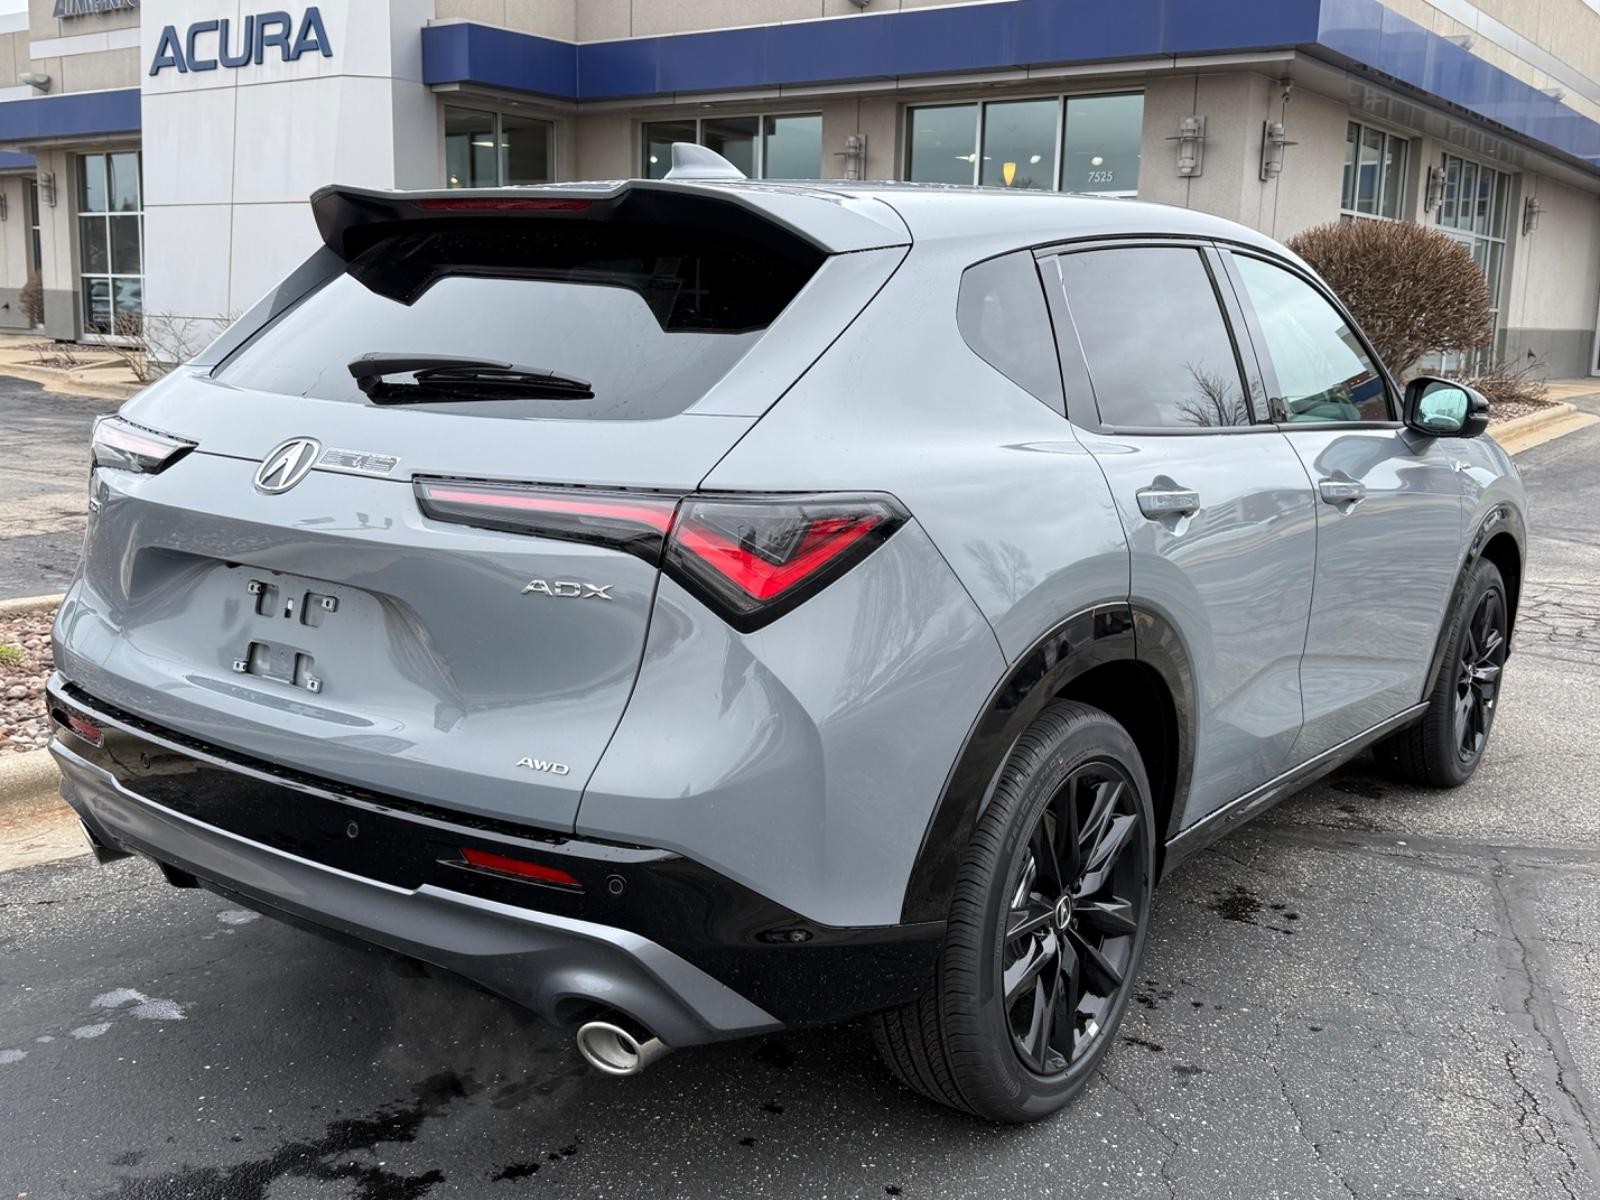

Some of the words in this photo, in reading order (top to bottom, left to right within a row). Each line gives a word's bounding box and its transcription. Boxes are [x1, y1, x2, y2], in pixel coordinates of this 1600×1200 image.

[149, 6, 333, 76] ACURA
[1088, 171, 1113, 183] 7525
[520, 579, 615, 600] ADX
[515, 757, 569, 775] AWD
